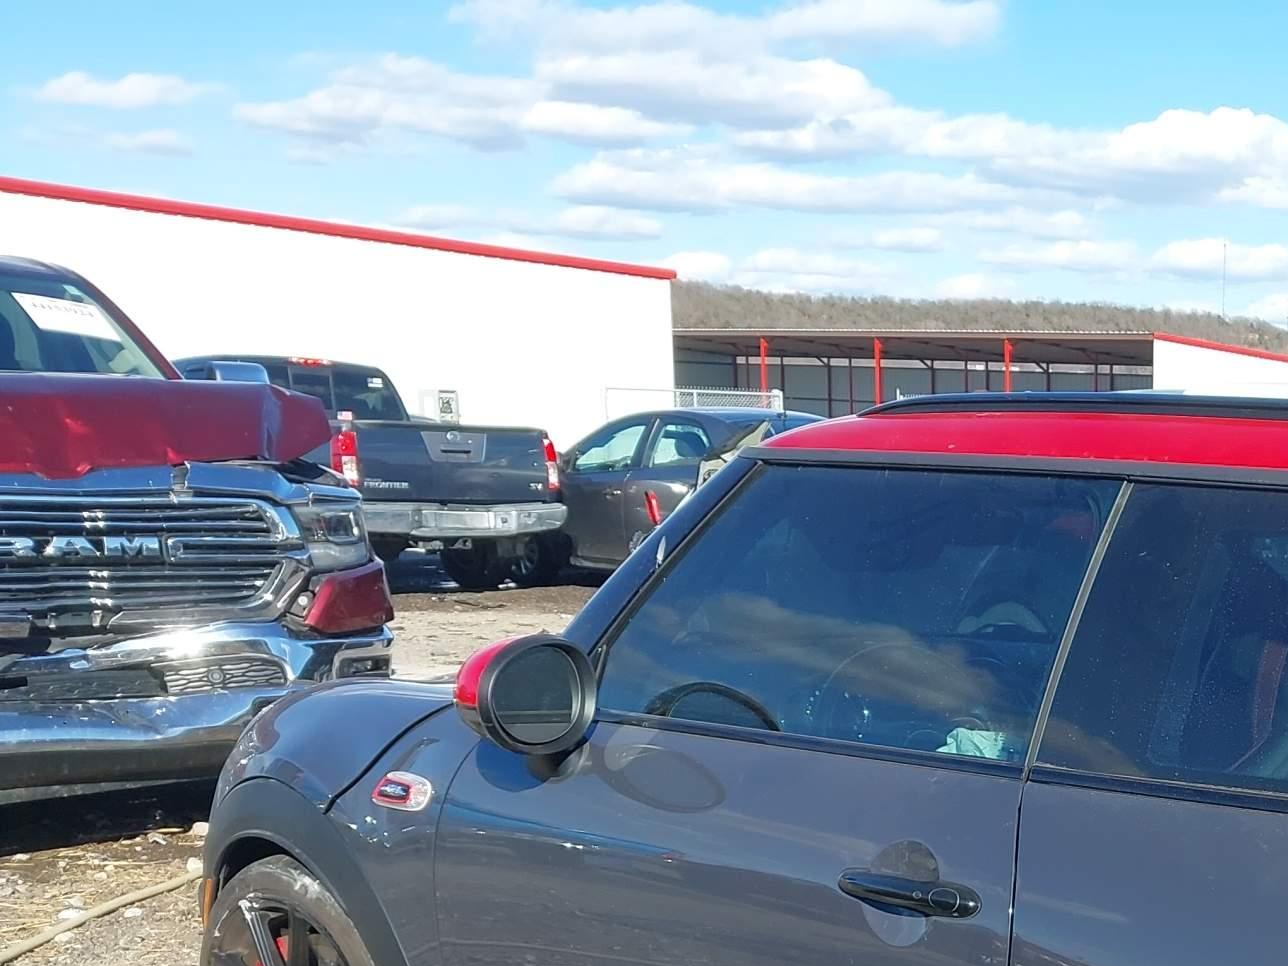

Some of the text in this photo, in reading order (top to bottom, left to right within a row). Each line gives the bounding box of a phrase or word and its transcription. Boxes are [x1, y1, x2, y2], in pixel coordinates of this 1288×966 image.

[363, 481, 409, 489] FRONTIER
[529, 482, 543, 490] SV
[0, 536, 161, 557] RAM
